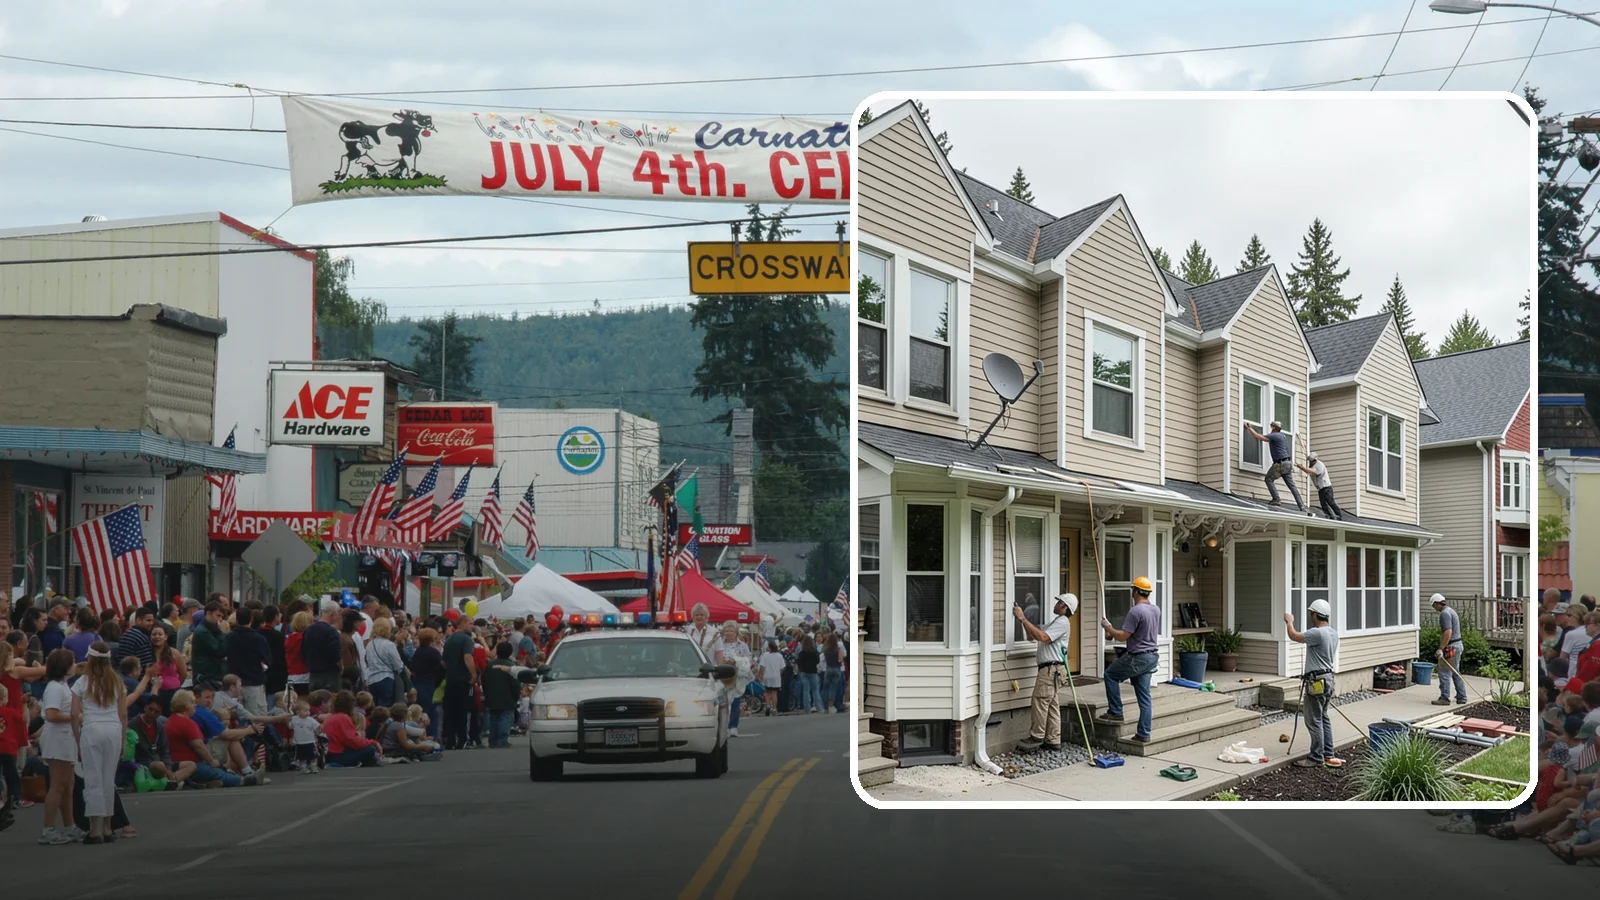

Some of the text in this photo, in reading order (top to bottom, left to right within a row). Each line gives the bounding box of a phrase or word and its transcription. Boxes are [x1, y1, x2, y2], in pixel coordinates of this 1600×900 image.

[695, 121, 850, 149] Carnat
[481, 141, 604, 192] JULY
[632, 150, 746, 198] 4th.
[697, 254, 850, 280] CROSSWA
[282, 379, 374, 420] ACE
[405, 409, 485, 422] CEDAR LOG
[283, 421, 371, 437] Hardware
[416, 427, 477, 447] Coca-Cola
[353, 467, 385, 480] Simpl
[95, 485, 124, 495] Vincent
[126, 486, 136, 495] de
[137, 486, 155, 495] Paul
[212, 516, 331, 535] HARDARE
[688, 526, 741, 536] CRNATION
[699, 535, 730, 544] GLASS
